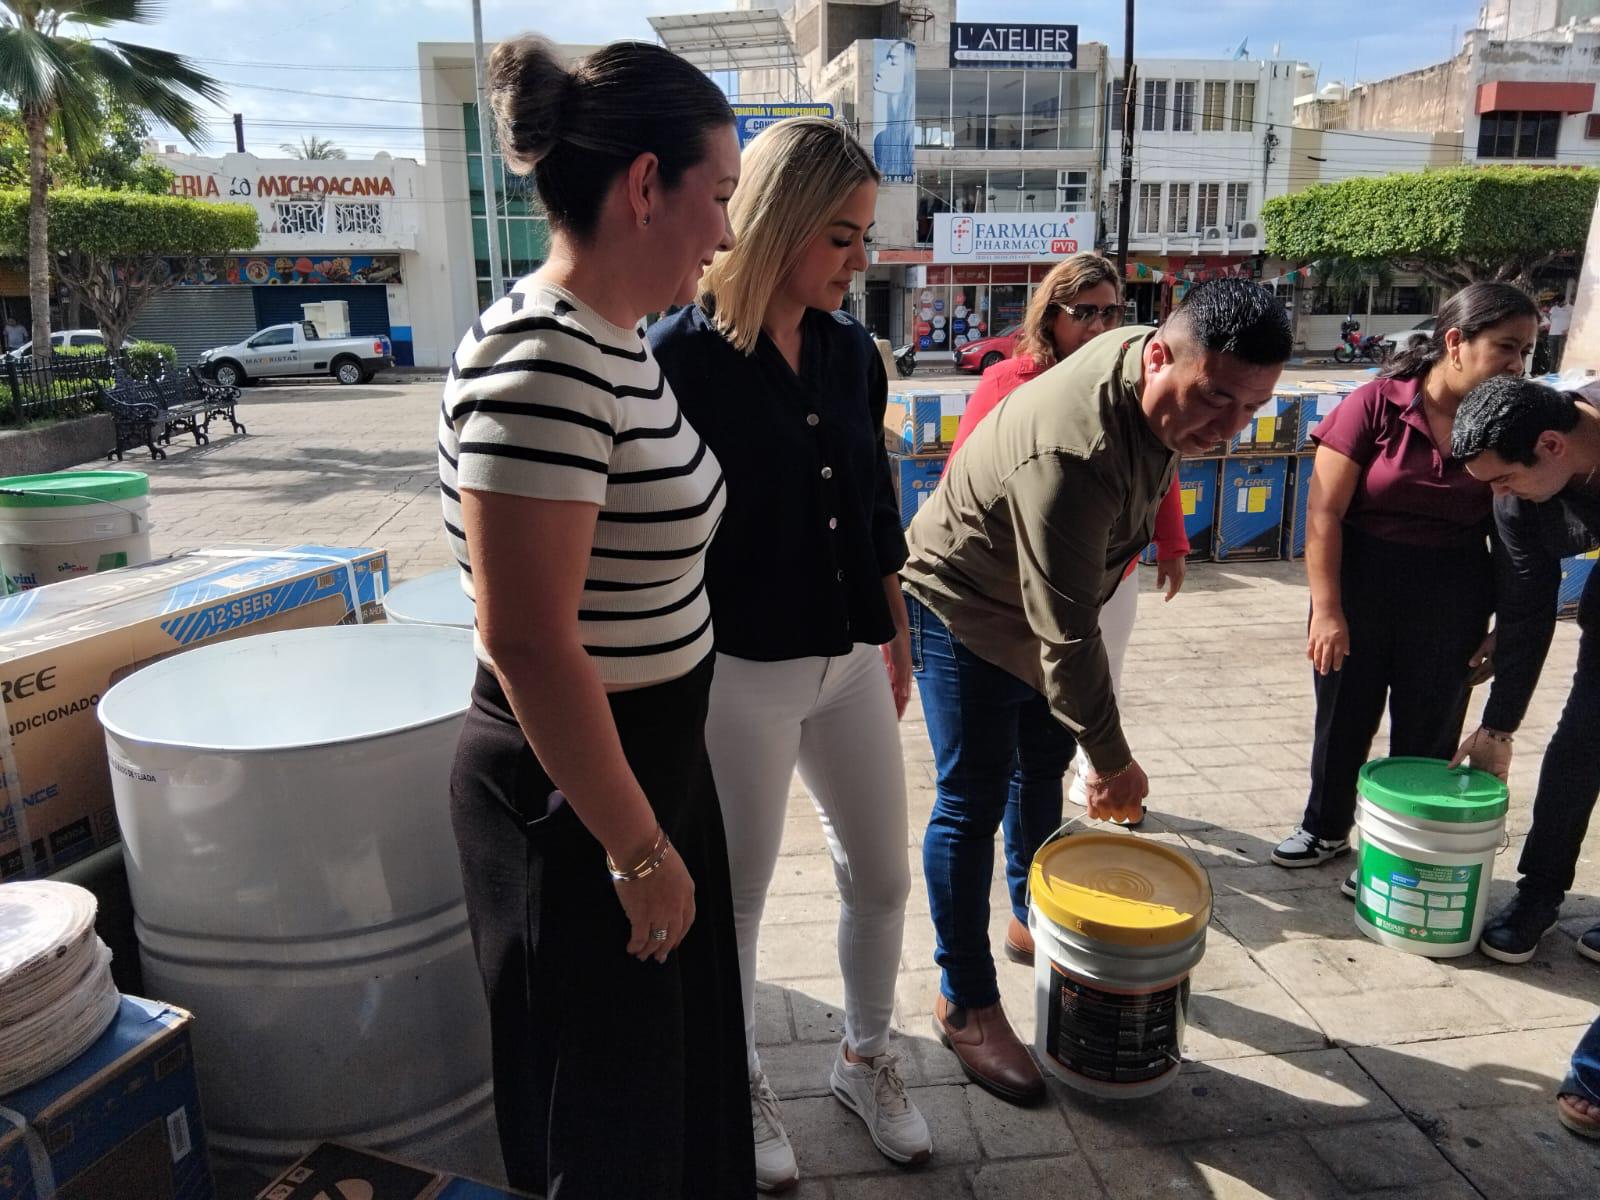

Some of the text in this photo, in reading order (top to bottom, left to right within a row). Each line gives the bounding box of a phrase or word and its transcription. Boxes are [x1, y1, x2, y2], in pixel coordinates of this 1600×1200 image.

[257, 175, 395, 197] MICHOACANA
[975, 222, 1070, 239] FARMACIA
[975, 239, 1076, 253] PHARMACY PVR
